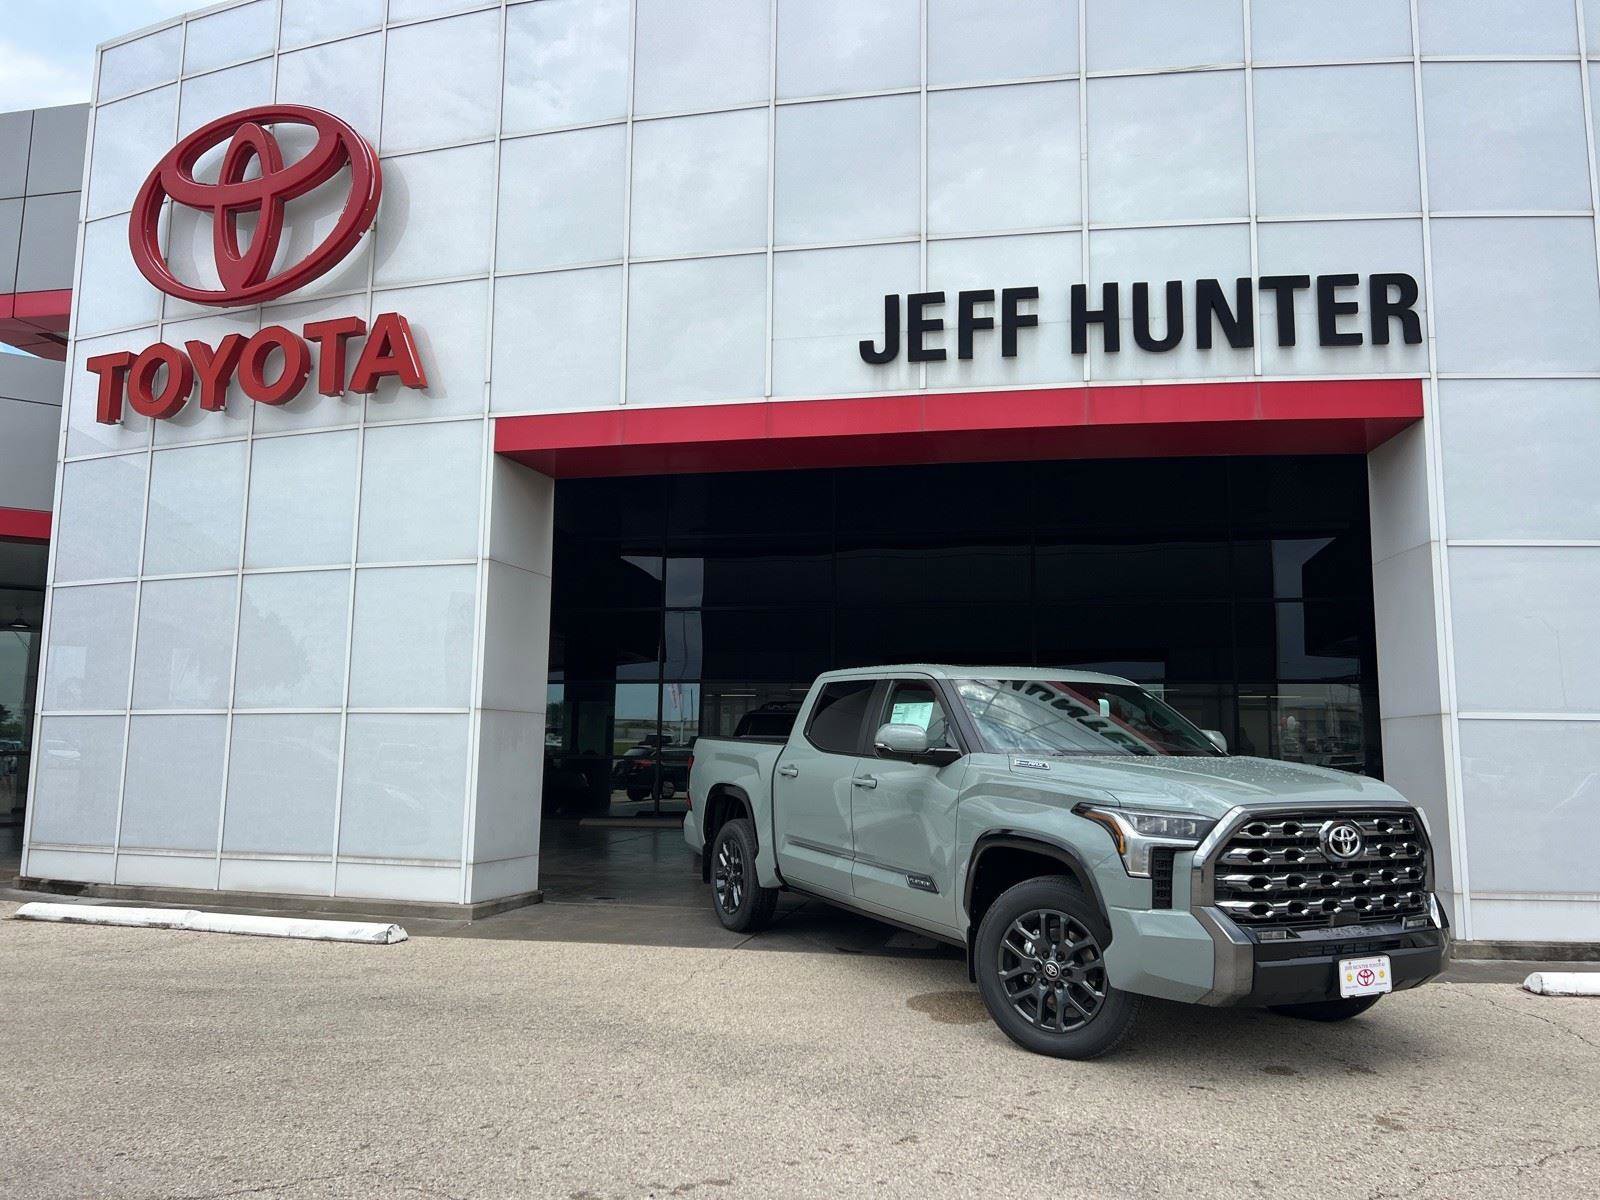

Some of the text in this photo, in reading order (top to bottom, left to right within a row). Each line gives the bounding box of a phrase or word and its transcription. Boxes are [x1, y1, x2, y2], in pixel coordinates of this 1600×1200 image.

[87, 312, 428, 425] TOYOTA
[859, 273, 1423, 364] JEFF HUNTER
